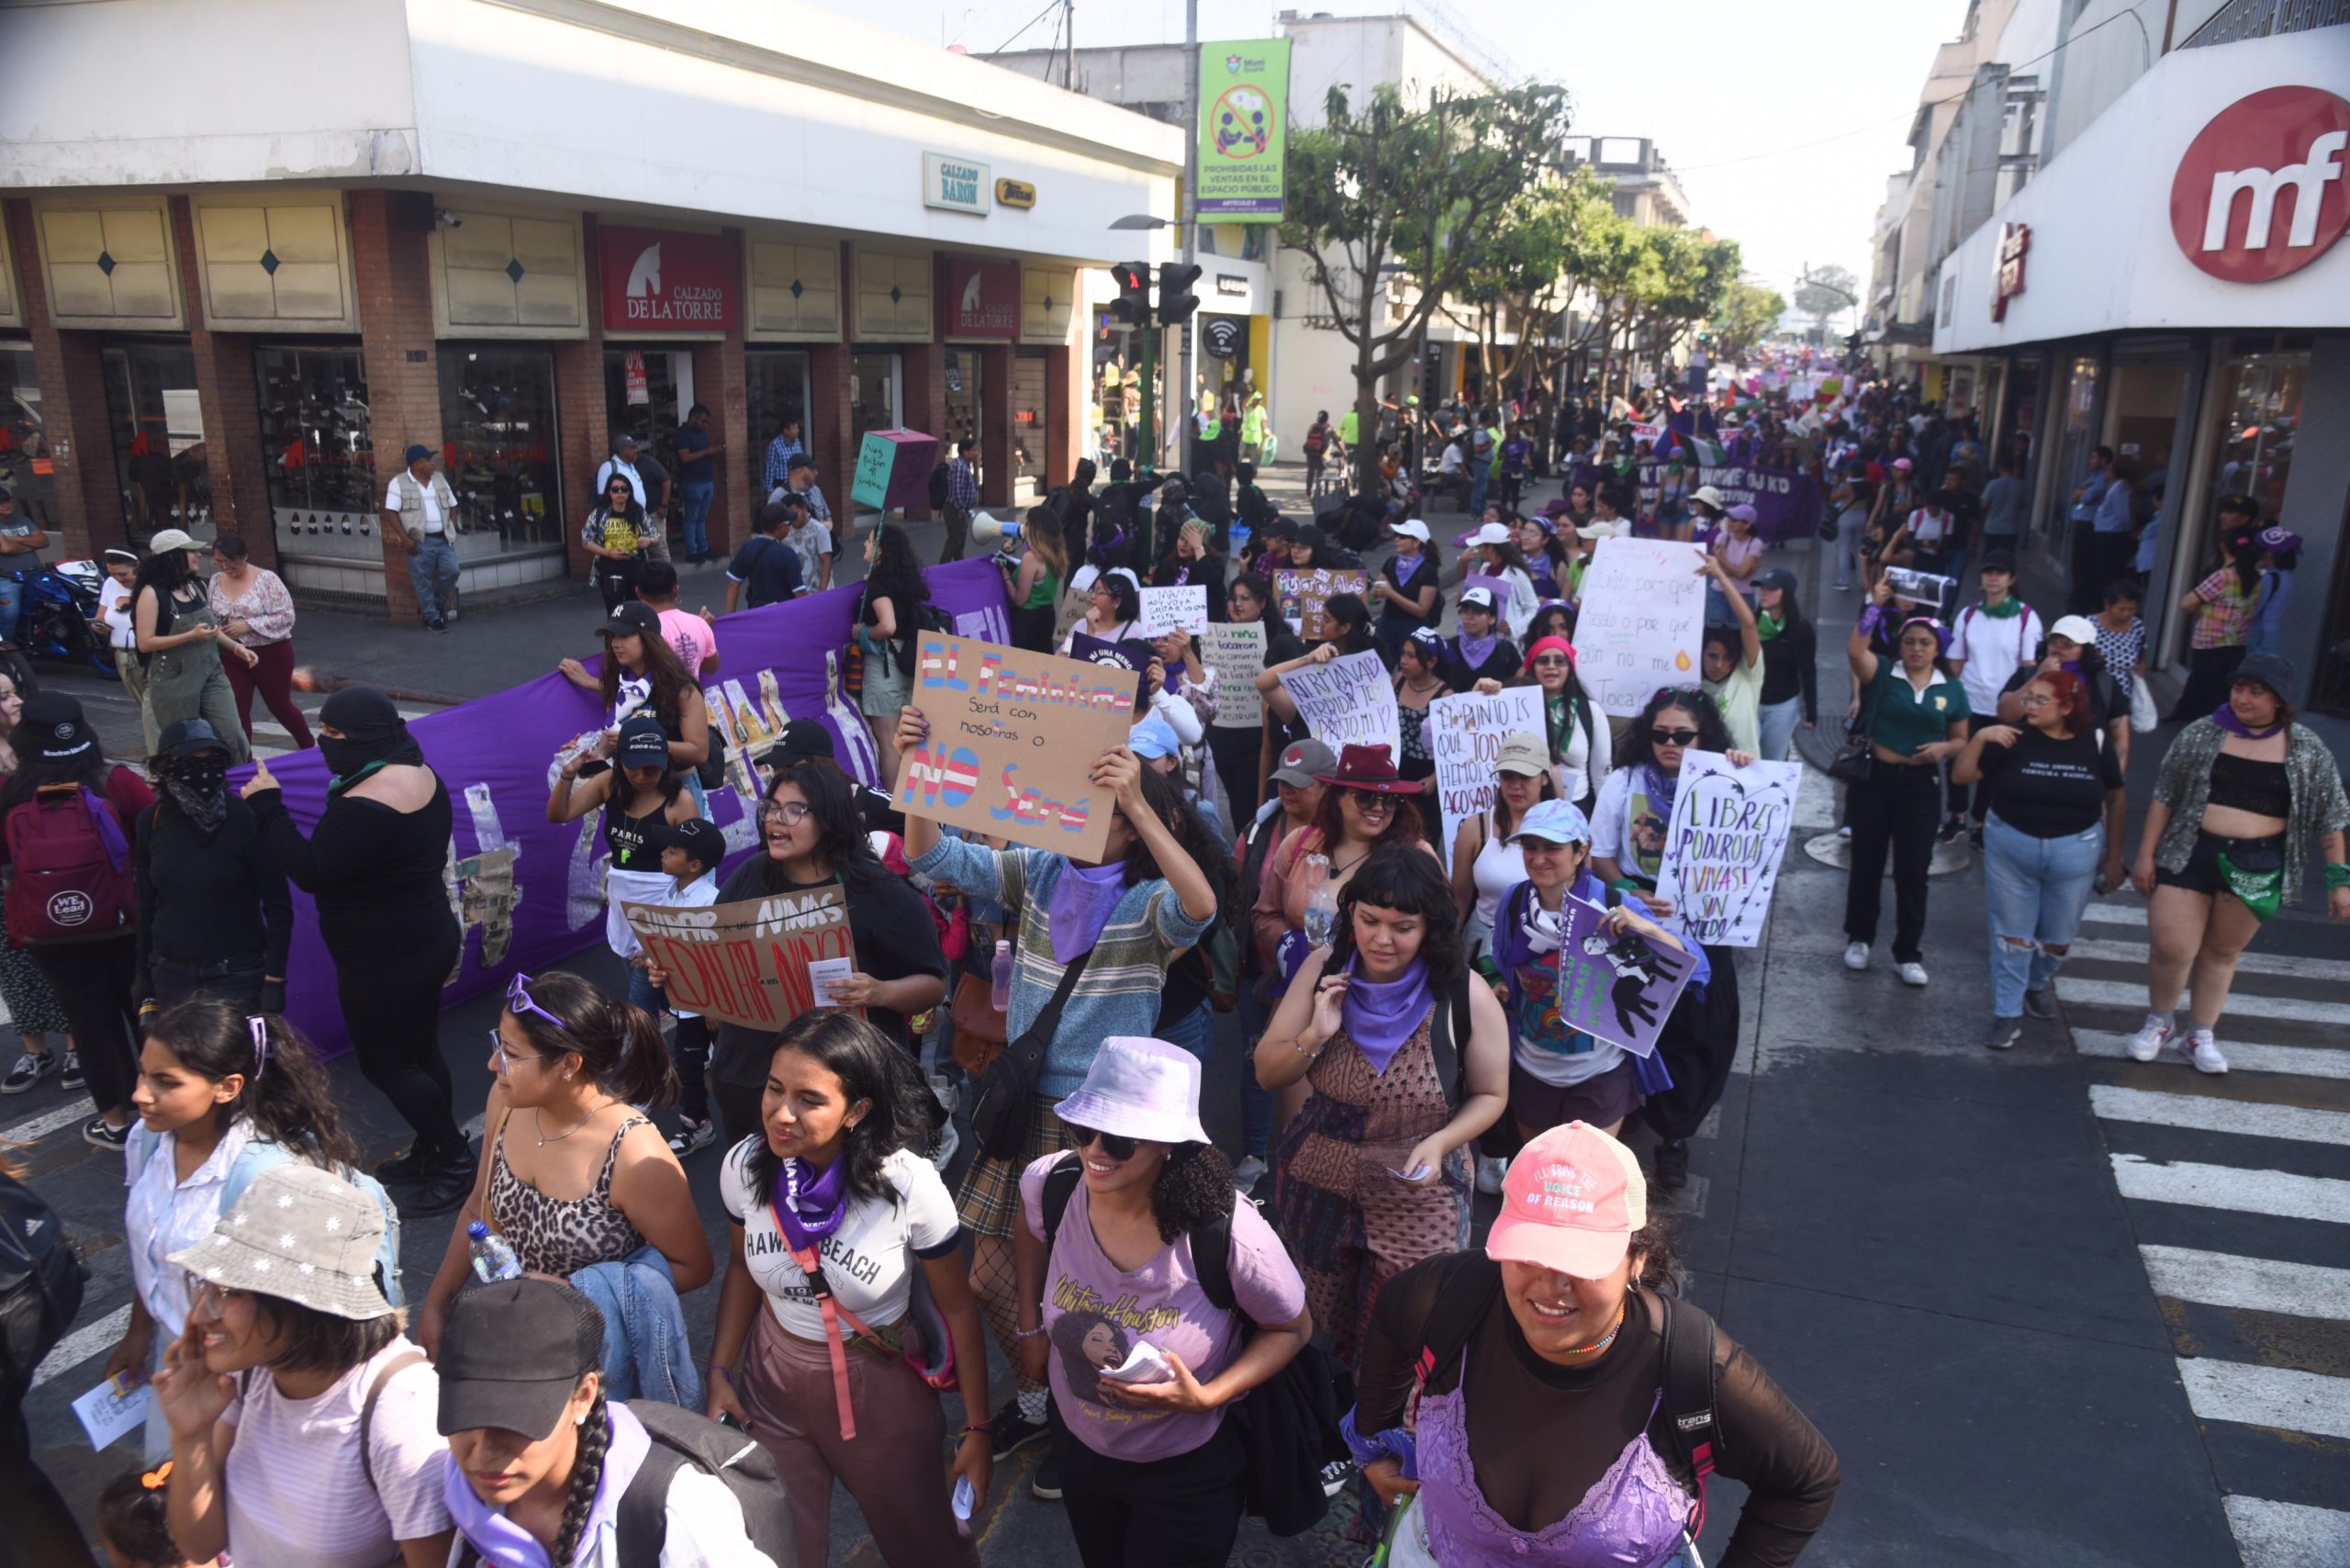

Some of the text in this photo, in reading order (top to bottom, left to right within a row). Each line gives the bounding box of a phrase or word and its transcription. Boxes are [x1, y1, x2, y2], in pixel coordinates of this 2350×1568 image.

[941, 162, 979, 183] CALZADO
[1204, 164, 1277, 174] PROHIBIDAS LAS
[1209, 174, 1270, 184] VENTAS EN EL
[1201, 185, 1239, 194] ESPACIO
[2203, 130, 2347, 252] mf
[674, 286, 722, 300] CALZADO
[627, 299, 723, 320] DE LA TORRE
[985, 314, 1013, 329] TORRE
[1217, 640, 1258, 650] tocaron
[1231, 629, 1259, 640] niña
[923, 643, 969, 690] EL
[1089, 648, 1133, 670] NI UNA MENO
[1616, 652, 1634, 668] no
[1651, 658, 1672, 672] me
[1355, 684, 1376, 707] TE
[969, 697, 1036, 721] Será con
[1440, 696, 1530, 732] EL PUNTO ES
[1360, 712, 1375, 735] MI
[1437, 732, 1465, 758] QUE
[902, 737, 980, 809] NO
[1439, 761, 1483, 788] HEMOS
[1442, 785, 1500, 815] ACOSADA
[1691, 790, 1782, 837] LIBRES
[610, 827, 644, 845] PARIS
[1677, 828, 1768, 869] PODEROSAS
[53, 901, 85, 914] Lead
[57, 895, 79, 907] WE
[1695, 893, 1729, 919] SIN
[627, 907, 720, 942] CUIDAR
[646, 935, 778, 1023] EDUCAR
[1550, 1163, 1578, 1179] BRING
[1579, 1171, 1599, 1192] THE
[1543, 1182, 1583, 1197] VOICE
[1527, 1193, 1595, 1214] OF REASON
[746, 1230, 881, 1286] HAW BEACH
[1108, 1294, 1181, 1335] Houston
[1678, 1414, 1711, 1426] trans
